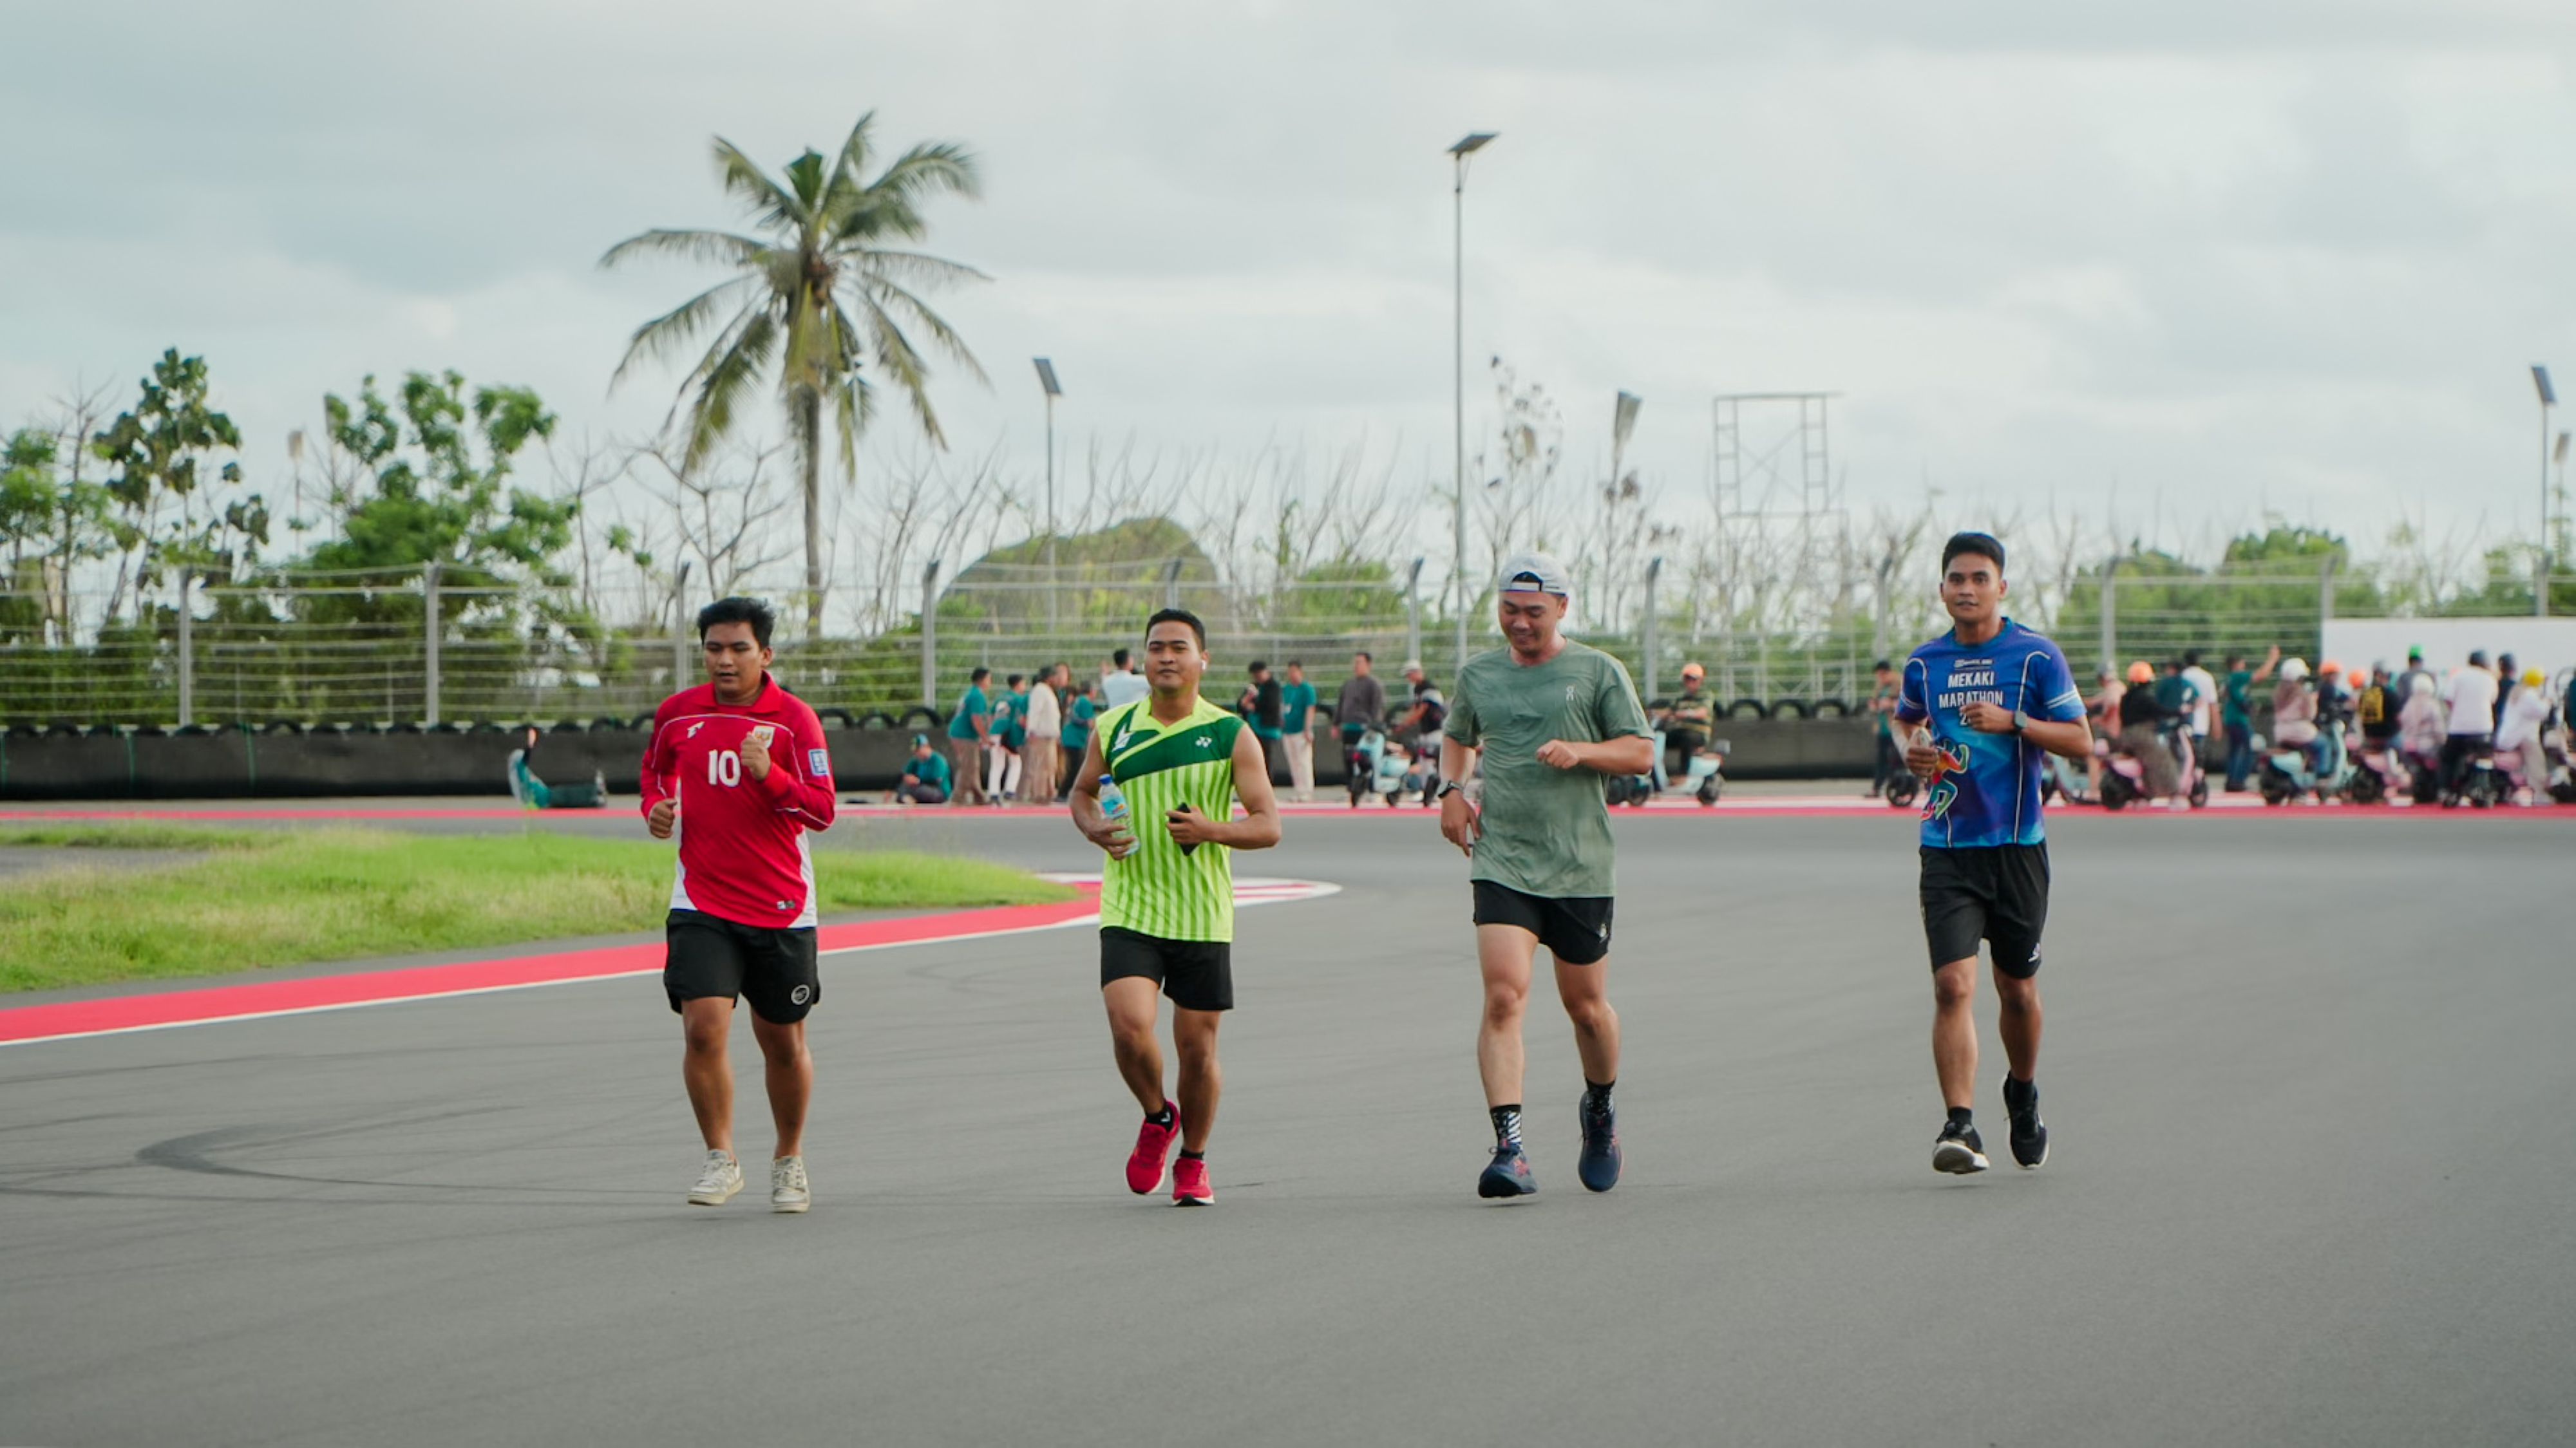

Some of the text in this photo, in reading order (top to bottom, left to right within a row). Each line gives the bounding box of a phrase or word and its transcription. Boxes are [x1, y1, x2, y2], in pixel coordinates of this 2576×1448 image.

[1947, 671, 1994, 688] MEKAKI
[1938, 690, 2003, 709] MARATHON
[708, 749, 741, 787] 10
